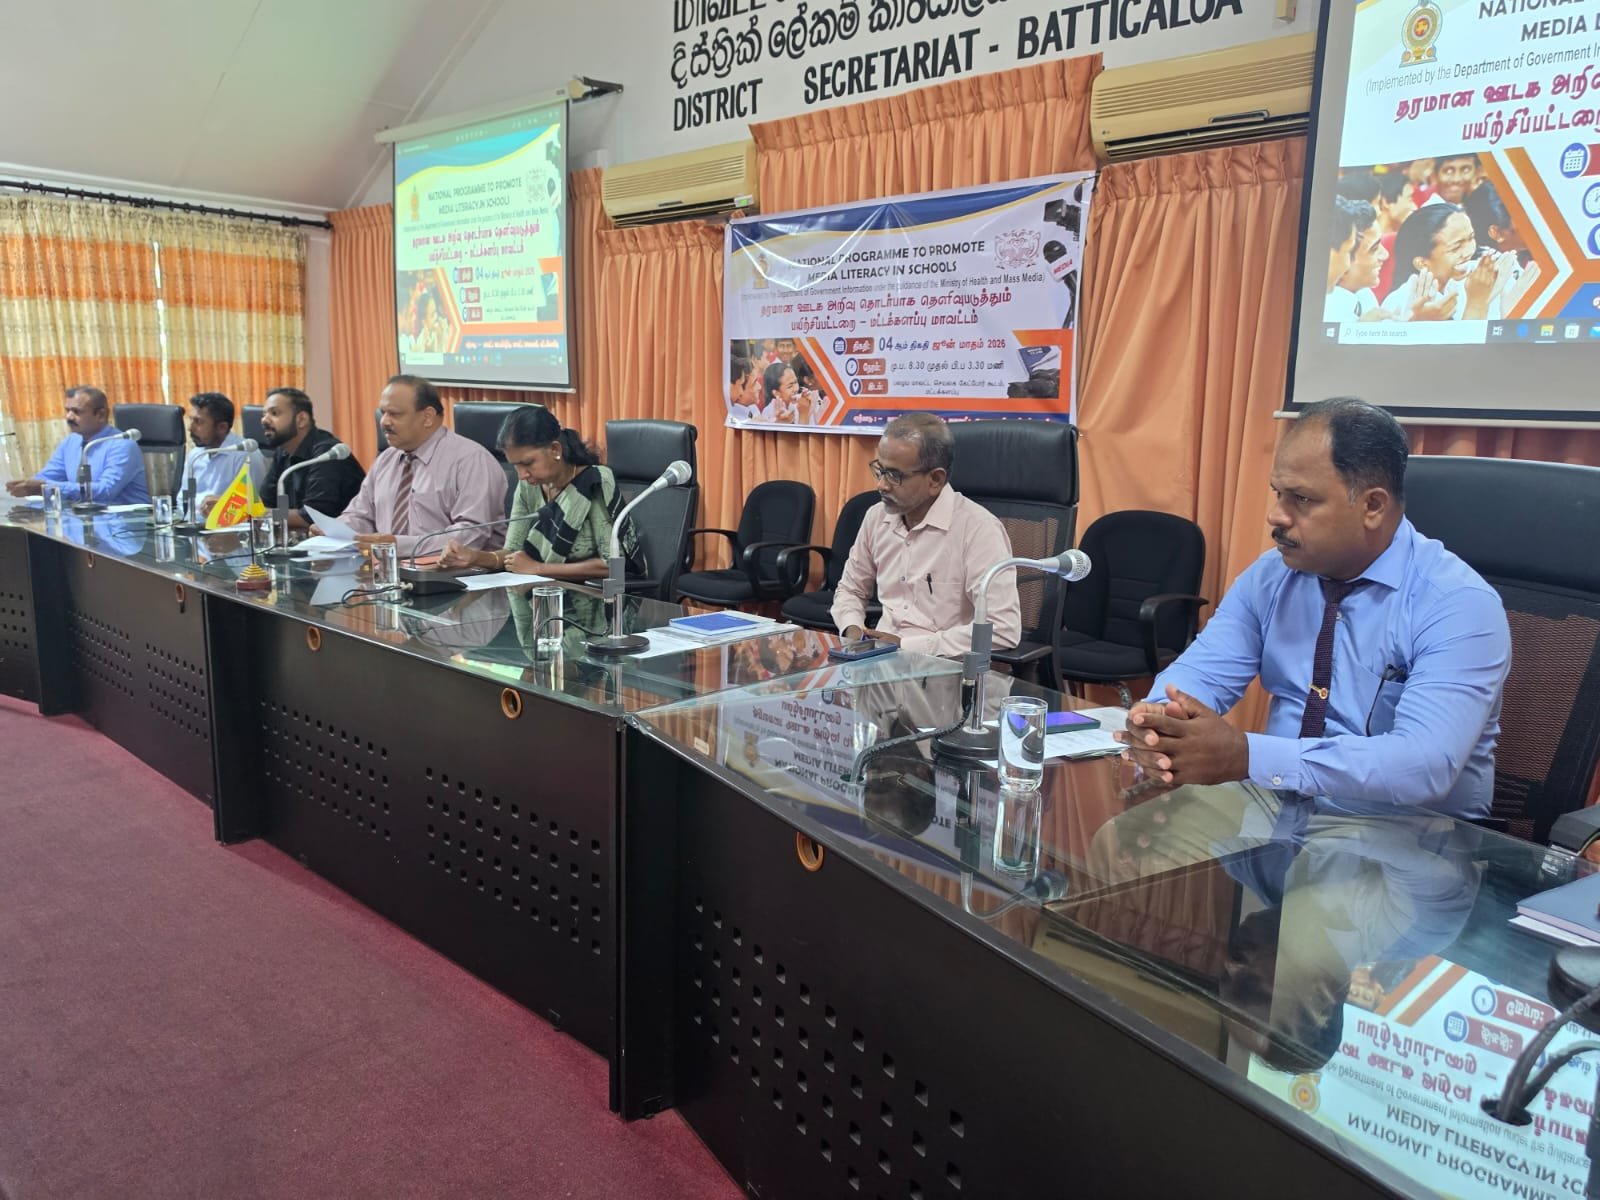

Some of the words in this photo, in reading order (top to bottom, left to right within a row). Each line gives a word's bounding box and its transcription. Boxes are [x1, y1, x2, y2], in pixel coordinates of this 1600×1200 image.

[1479, 0, 1585, 20] NATIO
[1521, 15, 1587, 42] MEDIA
[1424, 68, 1435, 87] by
[1438, 66, 1451, 80] the
[1453, 56, 1510, 80] Department
[1513, 53, 1525, 69] of
[1526, 44, 1592, 67] Government
[673, 78, 763, 131] DISTRICT
[804, 28, 981, 104] SECRETARIAT
[838, 247, 909, 264] PROGRAMME
[913, 246, 927, 258] TO
[929, 241, 985, 257] PROMOTE
[841, 266, 890, 281] LITERACY
[892, 264, 906, 276] IN
[908, 260, 957, 275] SCHOOLS
[969, 275, 988, 287] Health
[990, 274, 1002, 285] and
[1003, 274, 1021, 284] Mass
[878, 336, 894, 352] 04
[987, 338, 1006, 349] 2026
[908, 360, 925, 370] 8.30
[967, 360, 984, 370] 3.30
